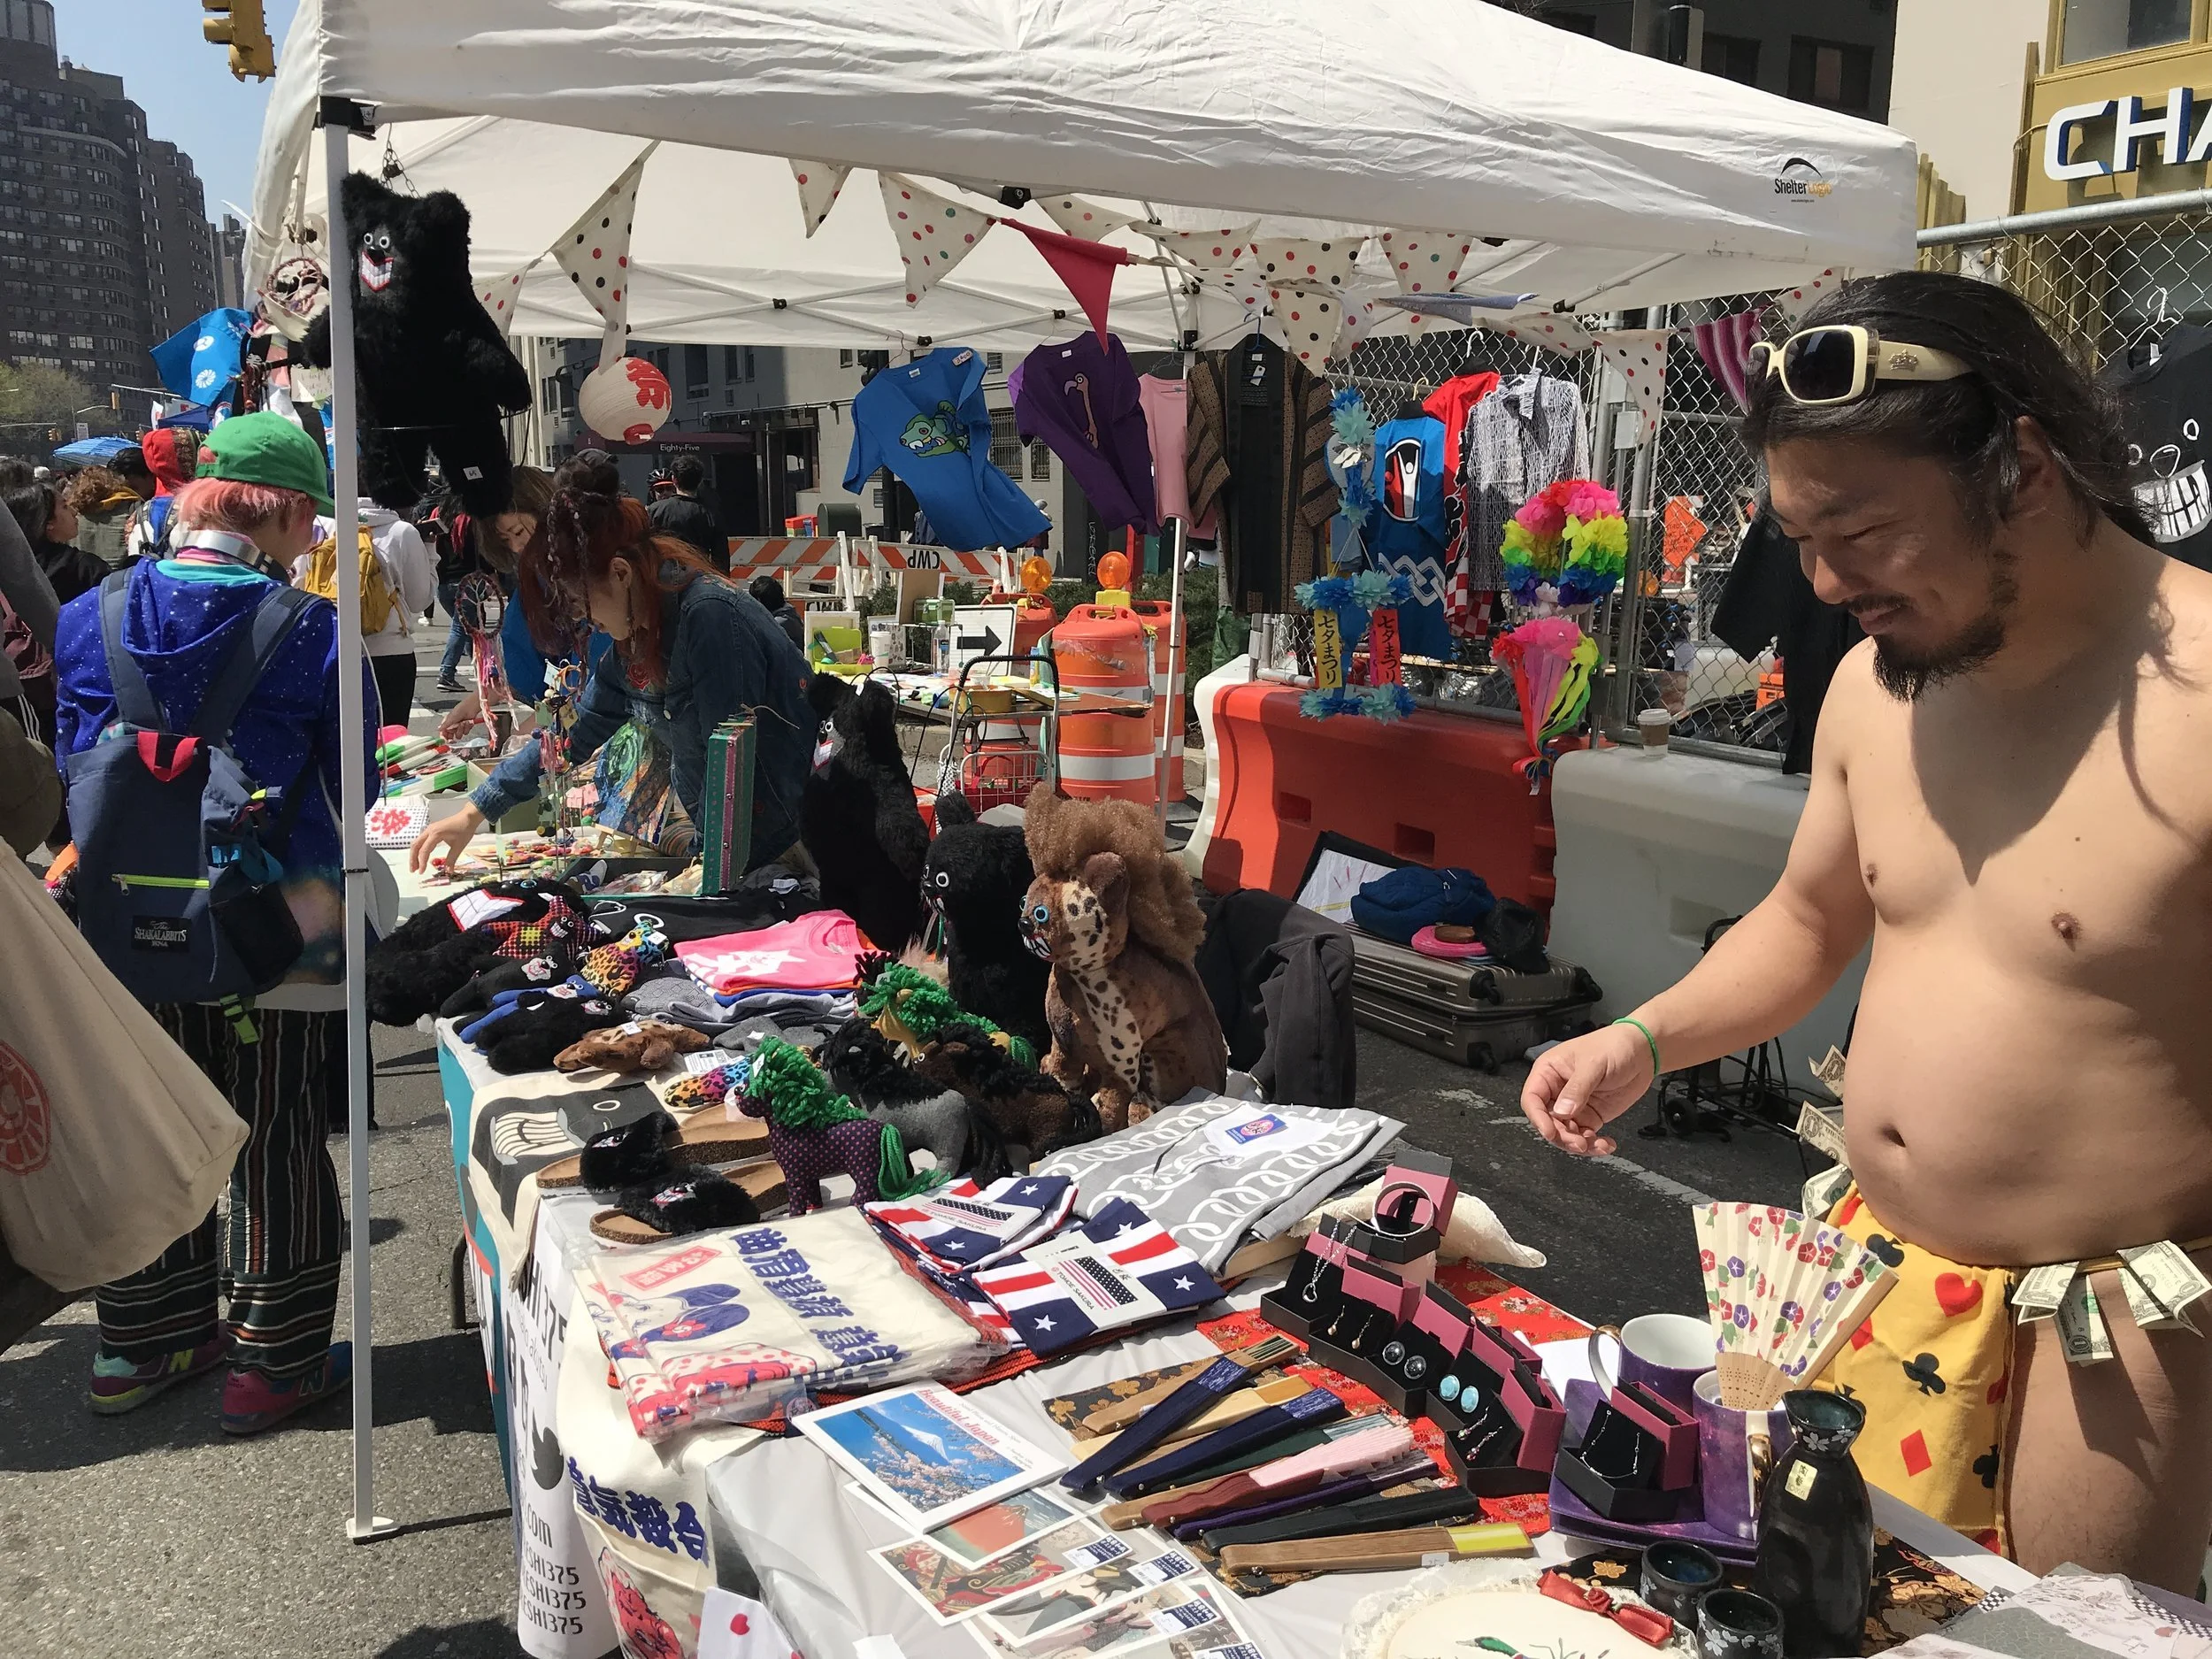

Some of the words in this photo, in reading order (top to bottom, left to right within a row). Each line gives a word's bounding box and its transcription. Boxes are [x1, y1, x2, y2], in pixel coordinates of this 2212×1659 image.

[660, 443, 700, 452] Eighty-Five
[907, 549, 940, 570] CWP
[1318, 616, 1339, 685] 七夕まつり
[1378, 616, 1398, 683] 七夕まつり
[134, 927, 187, 941] SHAKALABBITS
[1056, 1271, 1074, 1289] TOMOE
[1073, 1288, 1094, 1310] SAKURA
[920, 1389, 969, 1422] Beautiful
[964, 1423, 1000, 1446] Japan
[523, 1540, 580, 1586] ESHI375
[522, 1594, 584, 1635] ESHI375
